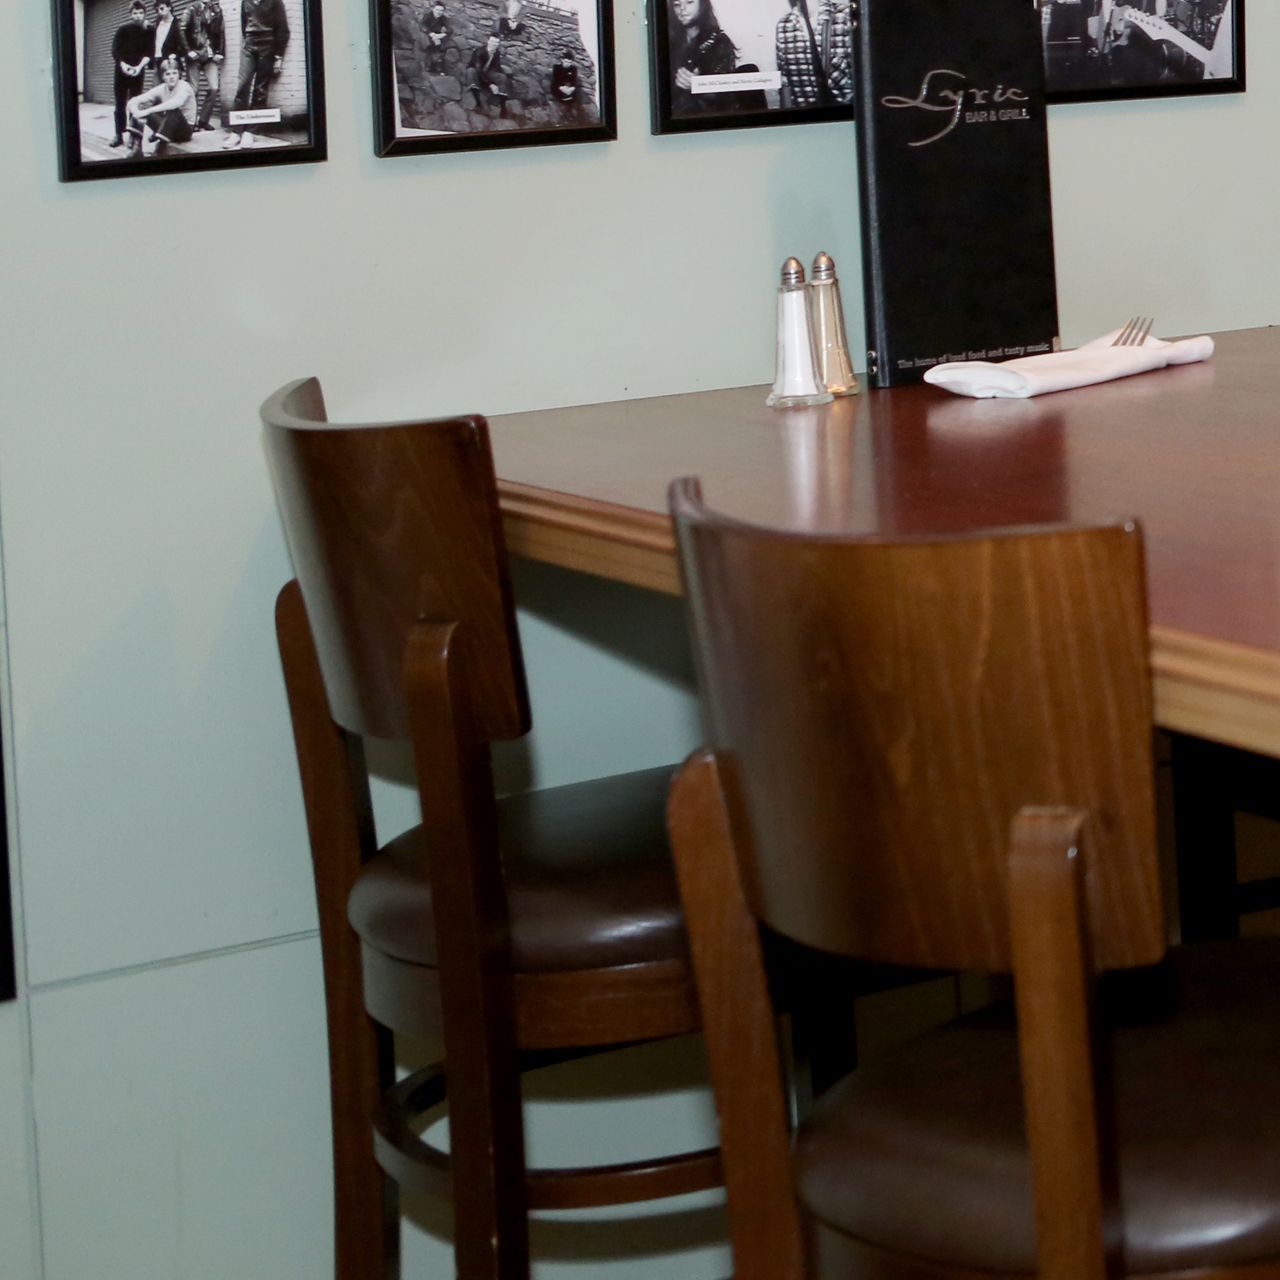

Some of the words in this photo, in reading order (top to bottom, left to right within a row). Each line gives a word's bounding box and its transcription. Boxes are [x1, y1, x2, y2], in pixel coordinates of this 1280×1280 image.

[881, 69, 1030, 147] Lyric
[965, 110, 988, 123] BAR
[989, 110, 997, 121] &
[999, 107, 1031, 121] GRILL
[897, 359, 912, 369] The
[915, 357, 937, 368] home
[939, 355, 948, 364] of
[968, 349, 986, 361] food
[988, 348, 1003, 358] and
[1005, 346, 1025, 356] tasty
[1027, 342, 1050, 353] music
